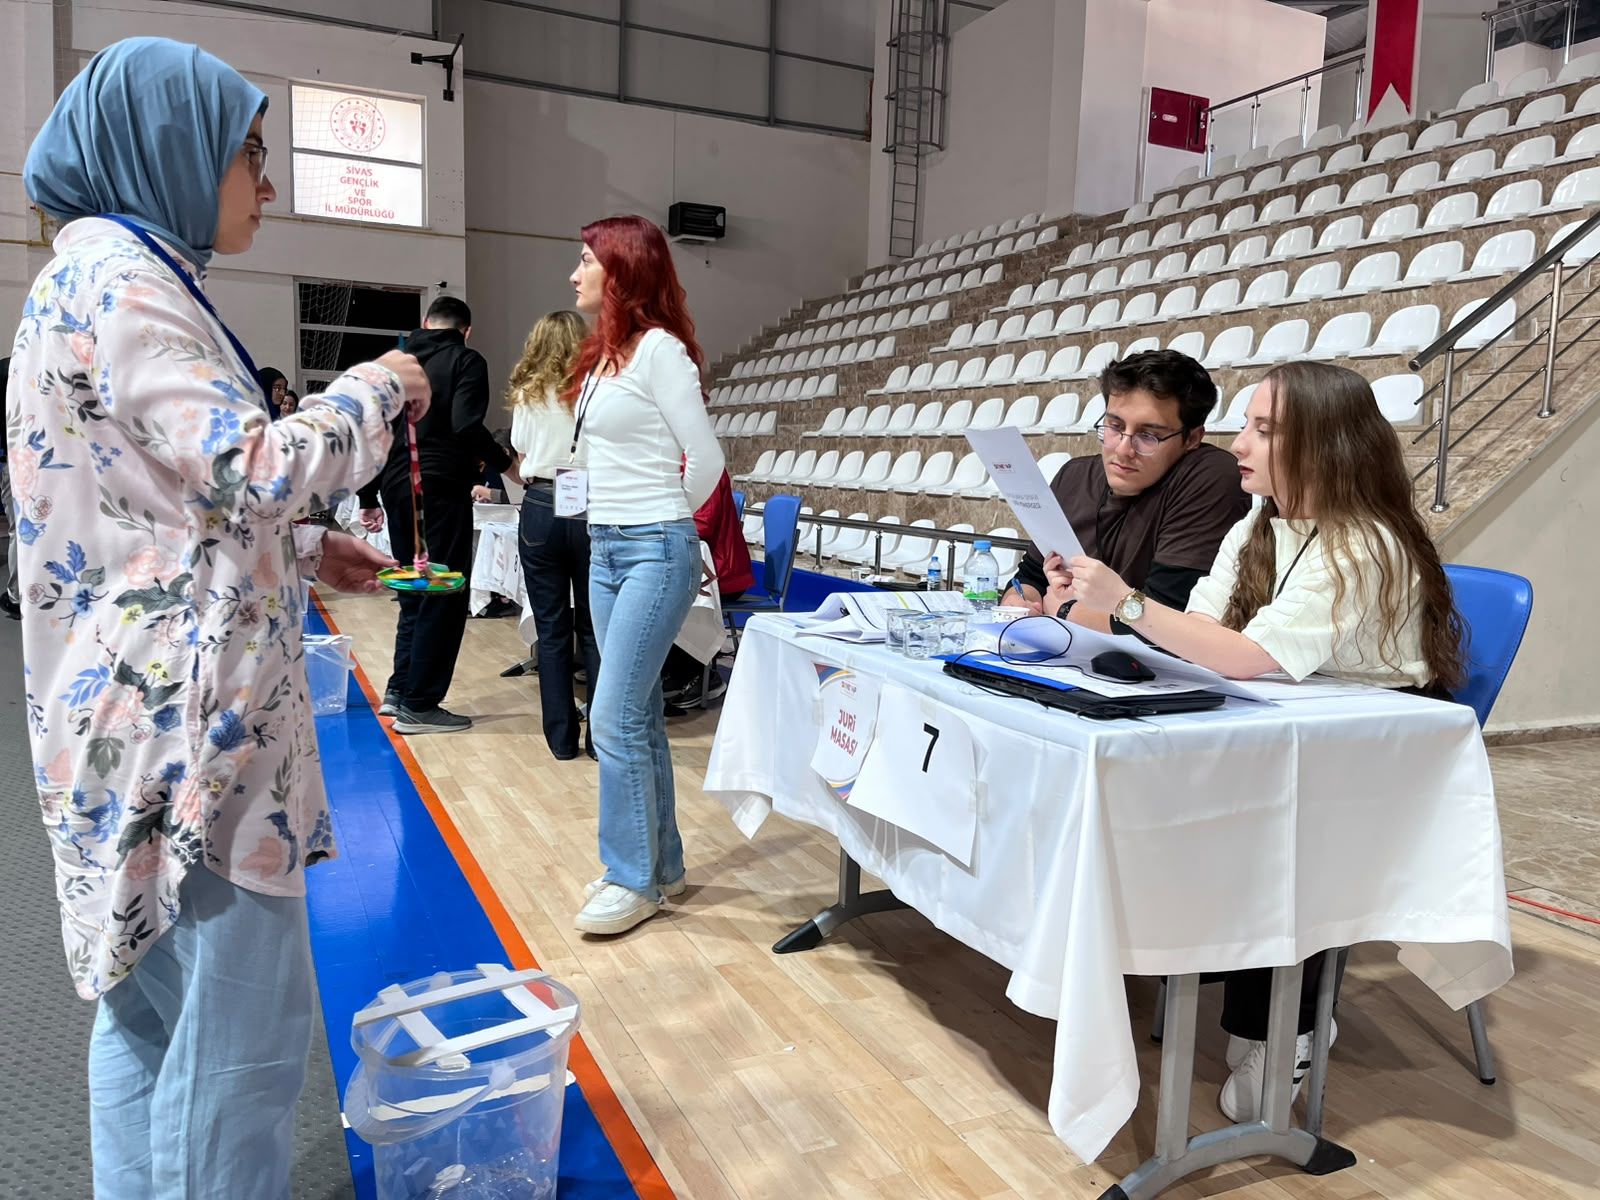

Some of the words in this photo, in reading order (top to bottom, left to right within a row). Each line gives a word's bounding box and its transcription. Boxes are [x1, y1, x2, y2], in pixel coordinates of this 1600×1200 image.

[346, 165, 373, 177] SİVAS
[340, 176, 379, 188] GENÇLİK
[354, 188, 366, 197] VE
[347, 196, 372, 206] SPOR
[921, 722, 940, 773] 7
